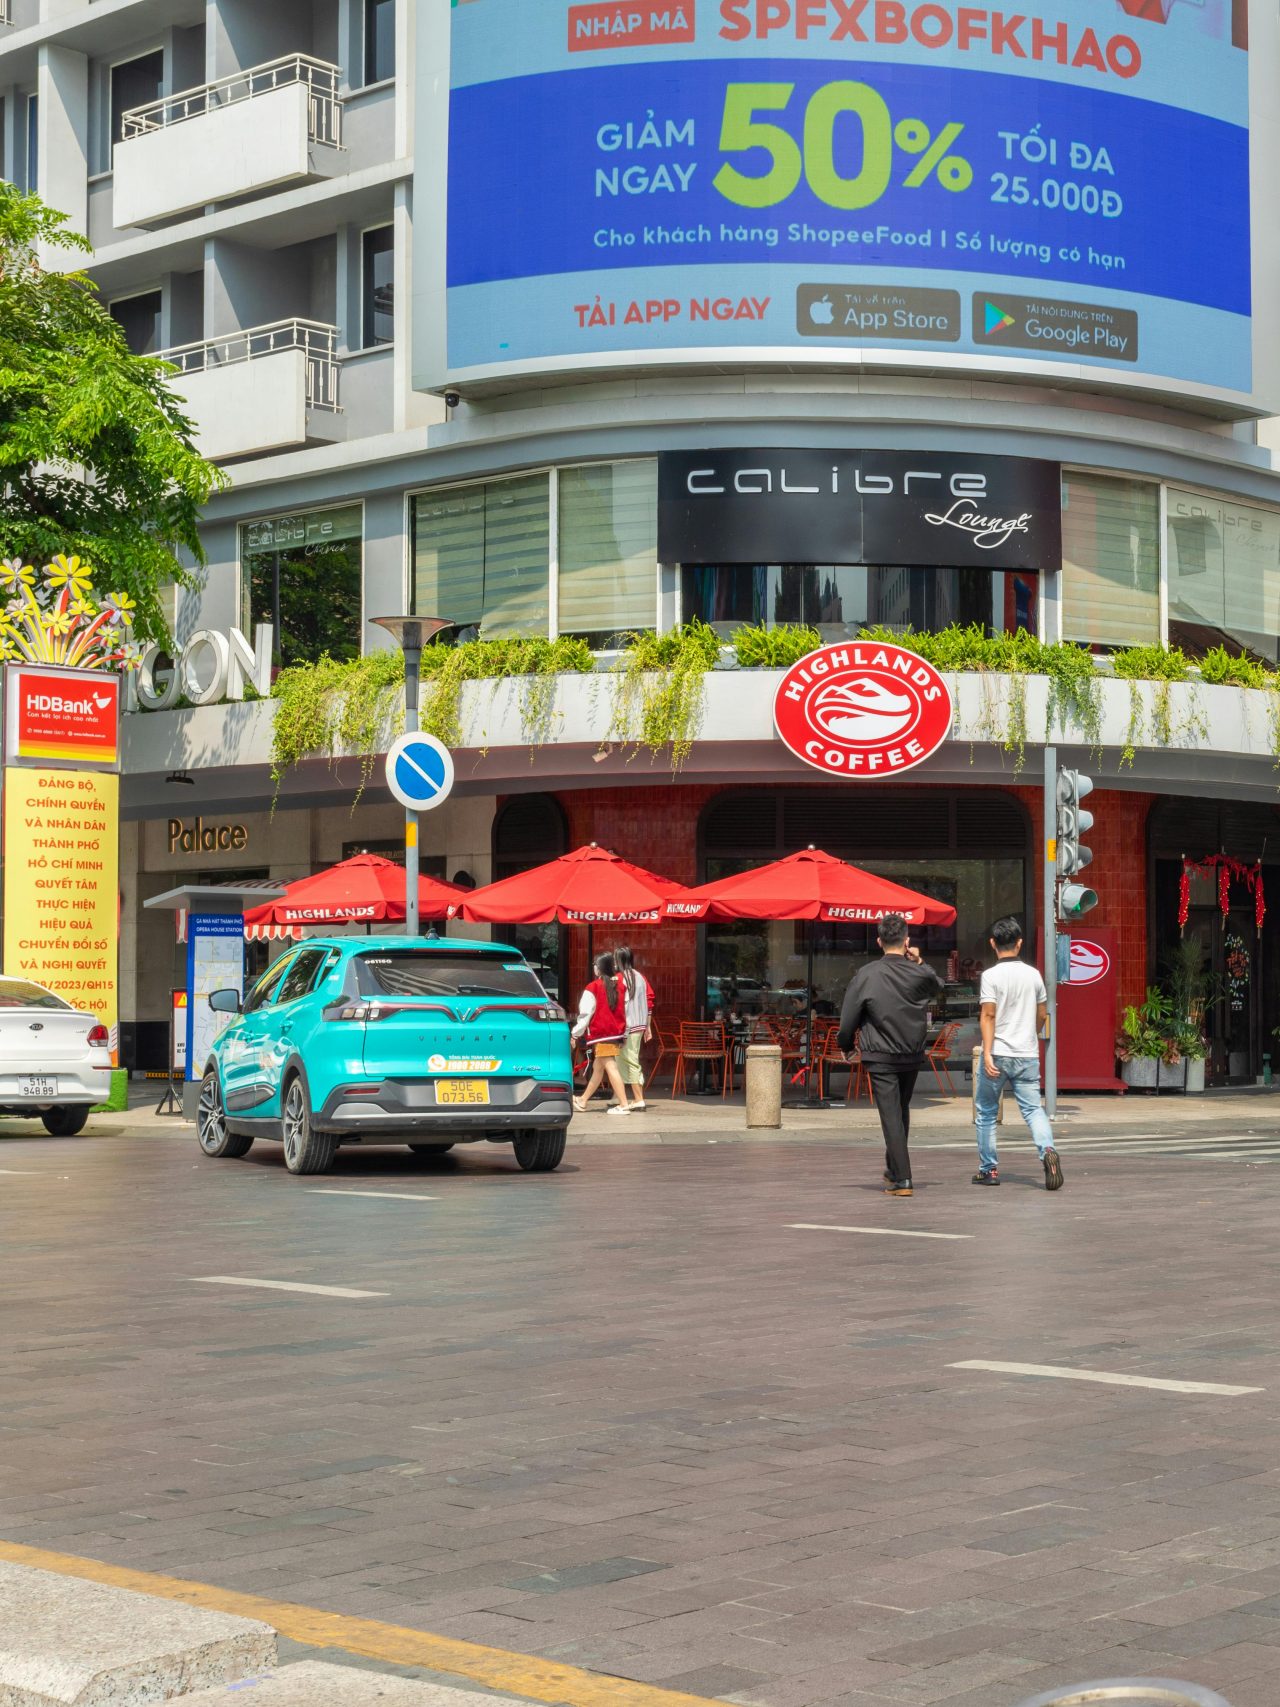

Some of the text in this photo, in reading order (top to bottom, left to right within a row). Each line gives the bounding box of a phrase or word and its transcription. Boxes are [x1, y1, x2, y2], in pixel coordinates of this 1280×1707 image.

[575, 6, 688, 38] NHẬP MÃ
[718, 0, 1141, 79] SPFXBOFKHAO
[596, 109, 695, 152] GIẢM
[712, 80, 973, 211] 50%
[998, 123, 1115, 175] TỐI ĐA
[595, 163, 697, 198] NGAY
[990, 173, 1123, 218] 25.000Đ
[593, 229, 635, 247] Cho
[643, 224, 711, 245] khách
[720, 224, 779, 247] hàng
[787, 223, 932, 248] ShopeeFood
[955, 231, 981, 251] Số
[989, 235, 1051, 262] lượng
[1058, 246, 1081, 262] có
[1088, 247, 1126, 270] hạn
[574, 295, 771, 327] TẢI APP NGAY
[844, 307, 948, 331] App Store
[1025, 318, 1128, 352] Google Play
[924, 498, 1032, 548] Lounge
[784, 648, 942, 703] HIGHLANDS
[27, 694, 93, 715] HDBank
[804, 738, 925, 771] COFFEE
[38, 778, 75, 789] ĐẢNG
[26, 796, 105, 811] CHÍNH QUYỀN
[25, 816, 106, 831] VÀ NHÂN DÂN
[168, 817, 248, 853] Palace
[32, 837, 100, 851] THÀNH PHỐ
[28, 855, 103, 870] HỒ CHÍ MINH
[35, 877, 97, 890] QUYẾT TÂM
[36, 899, 96, 912] THỰC HIỆN
[286, 906, 375, 920] HIGHLANDS
[567, 909, 659, 921] HIGHLANDS
[40, 918, 93, 931] HIỆU QUẢ
[19, 936, 108, 950] CHUYỂN ĐỔI SỐ
[20, 957, 107, 972] VÀ NGHỊ QUYẾT
[89, 1001, 107, 1013] HỘI
[30, 1077, 47, 1086] 51H
[451, 1081, 473, 1091] 50E
[23, 1086, 54, 1096] 948.89
[442, 1092, 484, 1103] 073.56
